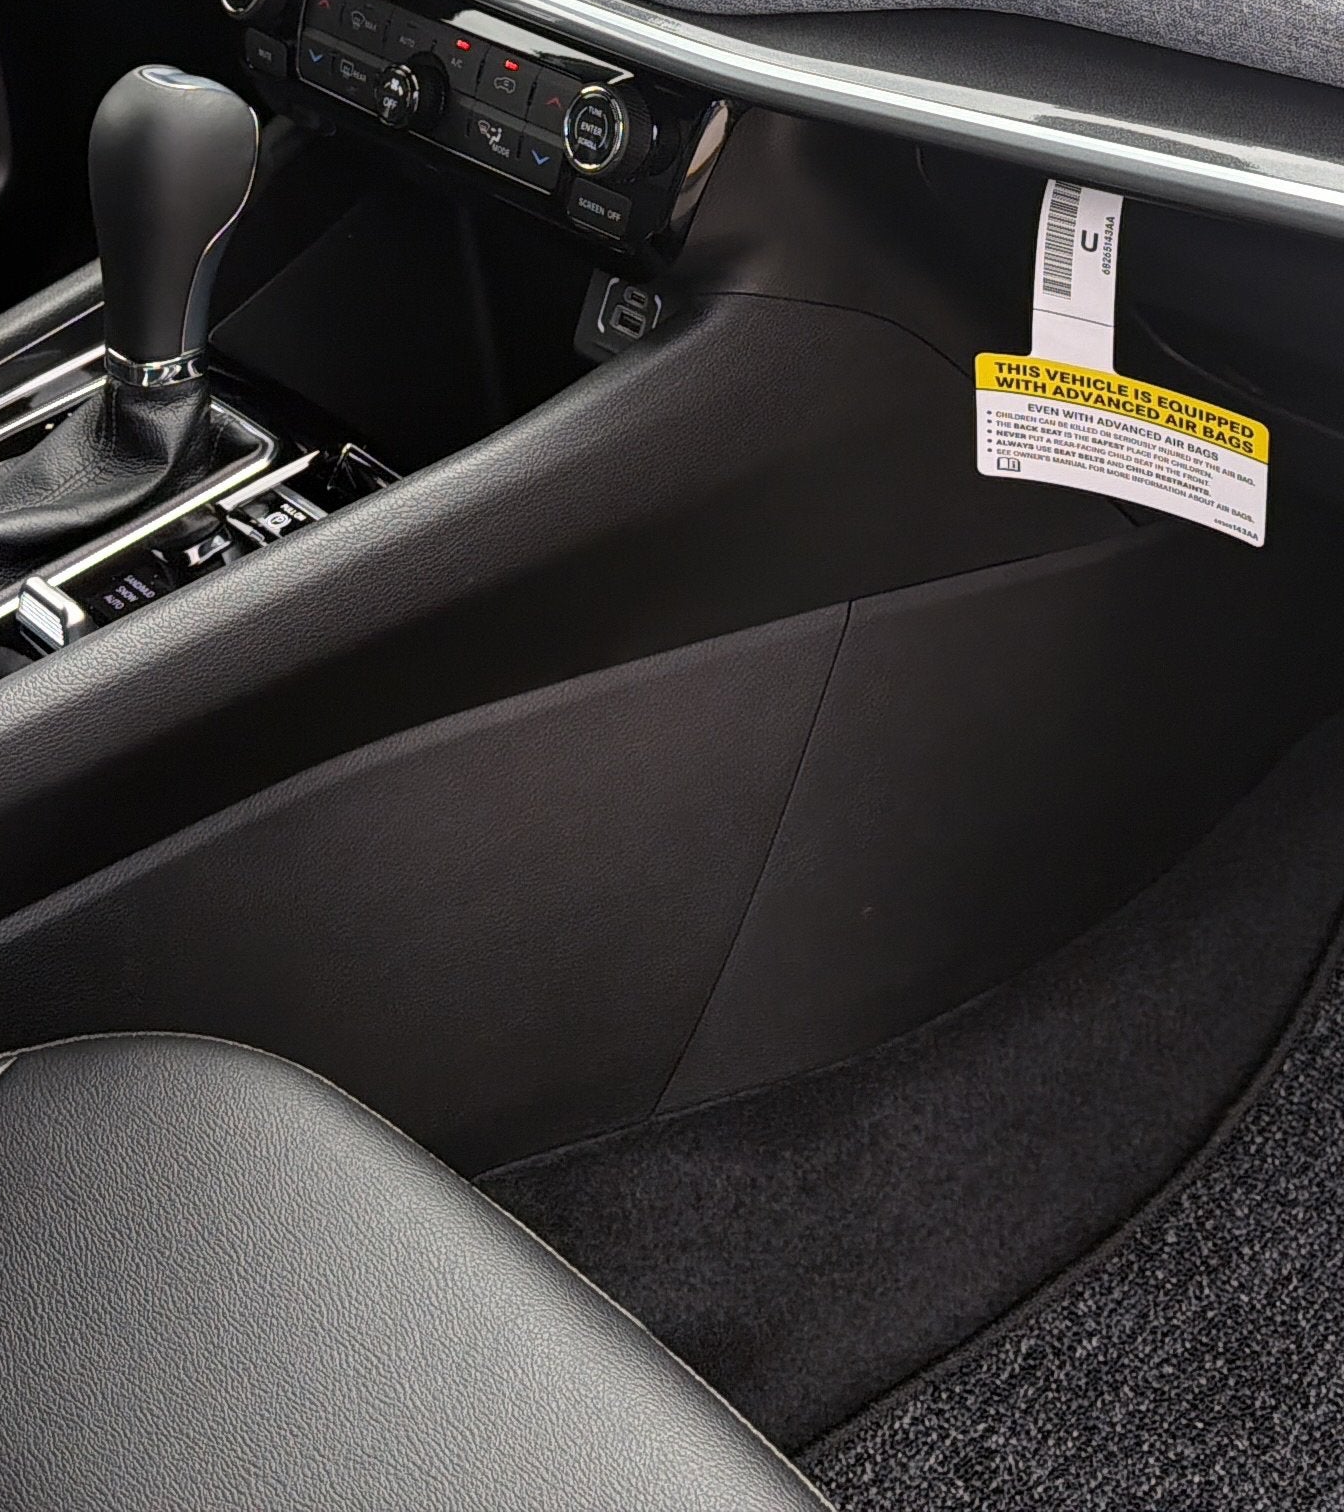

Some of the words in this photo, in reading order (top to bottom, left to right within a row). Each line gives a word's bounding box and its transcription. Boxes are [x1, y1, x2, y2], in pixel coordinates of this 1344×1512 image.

[399, 35, 415, 49] AUTO
[382, 97, 398, 110] OFF
[588, 105, 604, 118] TUNE
[580, 122, 603, 137] ENTER
[491, 144, 510, 158] MODE
[577, 136, 598, 151] SCROLL
[578, 197, 605, 216] SCREEN
[607, 209, 622, 222] OFF
[1081, 229, 1099, 253] U
[1101, 216, 1115, 276] 68265143AA
[994, 362, 1040, 378] THIS
[1045, 368, 1129, 397] VEHICLE
[1134, 389, 1152, 404] IS
[1158, 396, 1254, 439] EQUIPPED
[995, 376, 1046, 394] WITH
[1052, 386, 1160, 420] ADVANCED
[1165, 414, 1197, 434] AIR
[1203, 426, 1254, 454] BAGS
[995, 411, 1037, 423] CHILDREN
[1039, 417, 1056, 426] CAN
[1058, 421, 1068, 429] BE
[1070, 423, 1098, 435] KILLED
[1113, 433, 1157, 451] SERIOUSLY
[1158, 446, 1192, 462] INJURED
[1193, 457, 1203, 466] BY
[1205, 461, 1221, 473] THE
[1222, 468, 1235, 478] AIR
[1027, 403, 1059, 417] EVEN
[1062, 409, 1094, 423] WITH
[1097, 417, 1162, 441] ADVANCED
[1164, 435, 1184, 449] AIR
[1187, 443, 1219, 461] BAGS
[995, 420, 1012, 429] THE
[1014, 422, 1038, 433] BACK
[1040, 427, 1063, 437] SEAT
[1074, 433, 1090, 443] THE
[1091, 437, 1125, 451] SAFEST
[1126, 446, 1151, 458] PLACE
[1153, 453, 1169, 465] FOR
[1171, 458, 1214, 480] CHILDREN.
[996, 429, 1026, 440] NEVER
[1028, 434, 1044, 442] PUT
[1053, 438, 1106, 455] REAR-FACING
[1108, 450, 1132, 462] CHILD
[1134, 457, 1154, 468] SEAT
[1155, 463, 1164, 472] IN
[1166, 466, 1181, 476] THE
[996, 439, 1034, 450] ALWAYS
[1036, 445, 1052, 453] USE
[1054, 448, 1076, 458] SEAT
[1078, 452, 1105, 464] BELTS
[1106, 459, 1124, 469] AND
[1125, 464, 1154, 477] CHILD
[1155, 472, 1212, 498] RESTRAINTS.
[996, 448, 1012, 456] SEE
[1013, 450, 1051, 462] OWNER'S
[1052, 456, 1088, 470] MANUAL
[1088, 463, 1105, 473] FOR
[1106, 468, 1131, 480] MORE
[1132, 474, 1187, 498] INFORMATION
[1188, 492, 1215, 507] ABOUT
[1216, 502, 1230, 513] AIR
[103, 594, 125, 610] AUTO
[115, 585, 138, 603] SNOW
